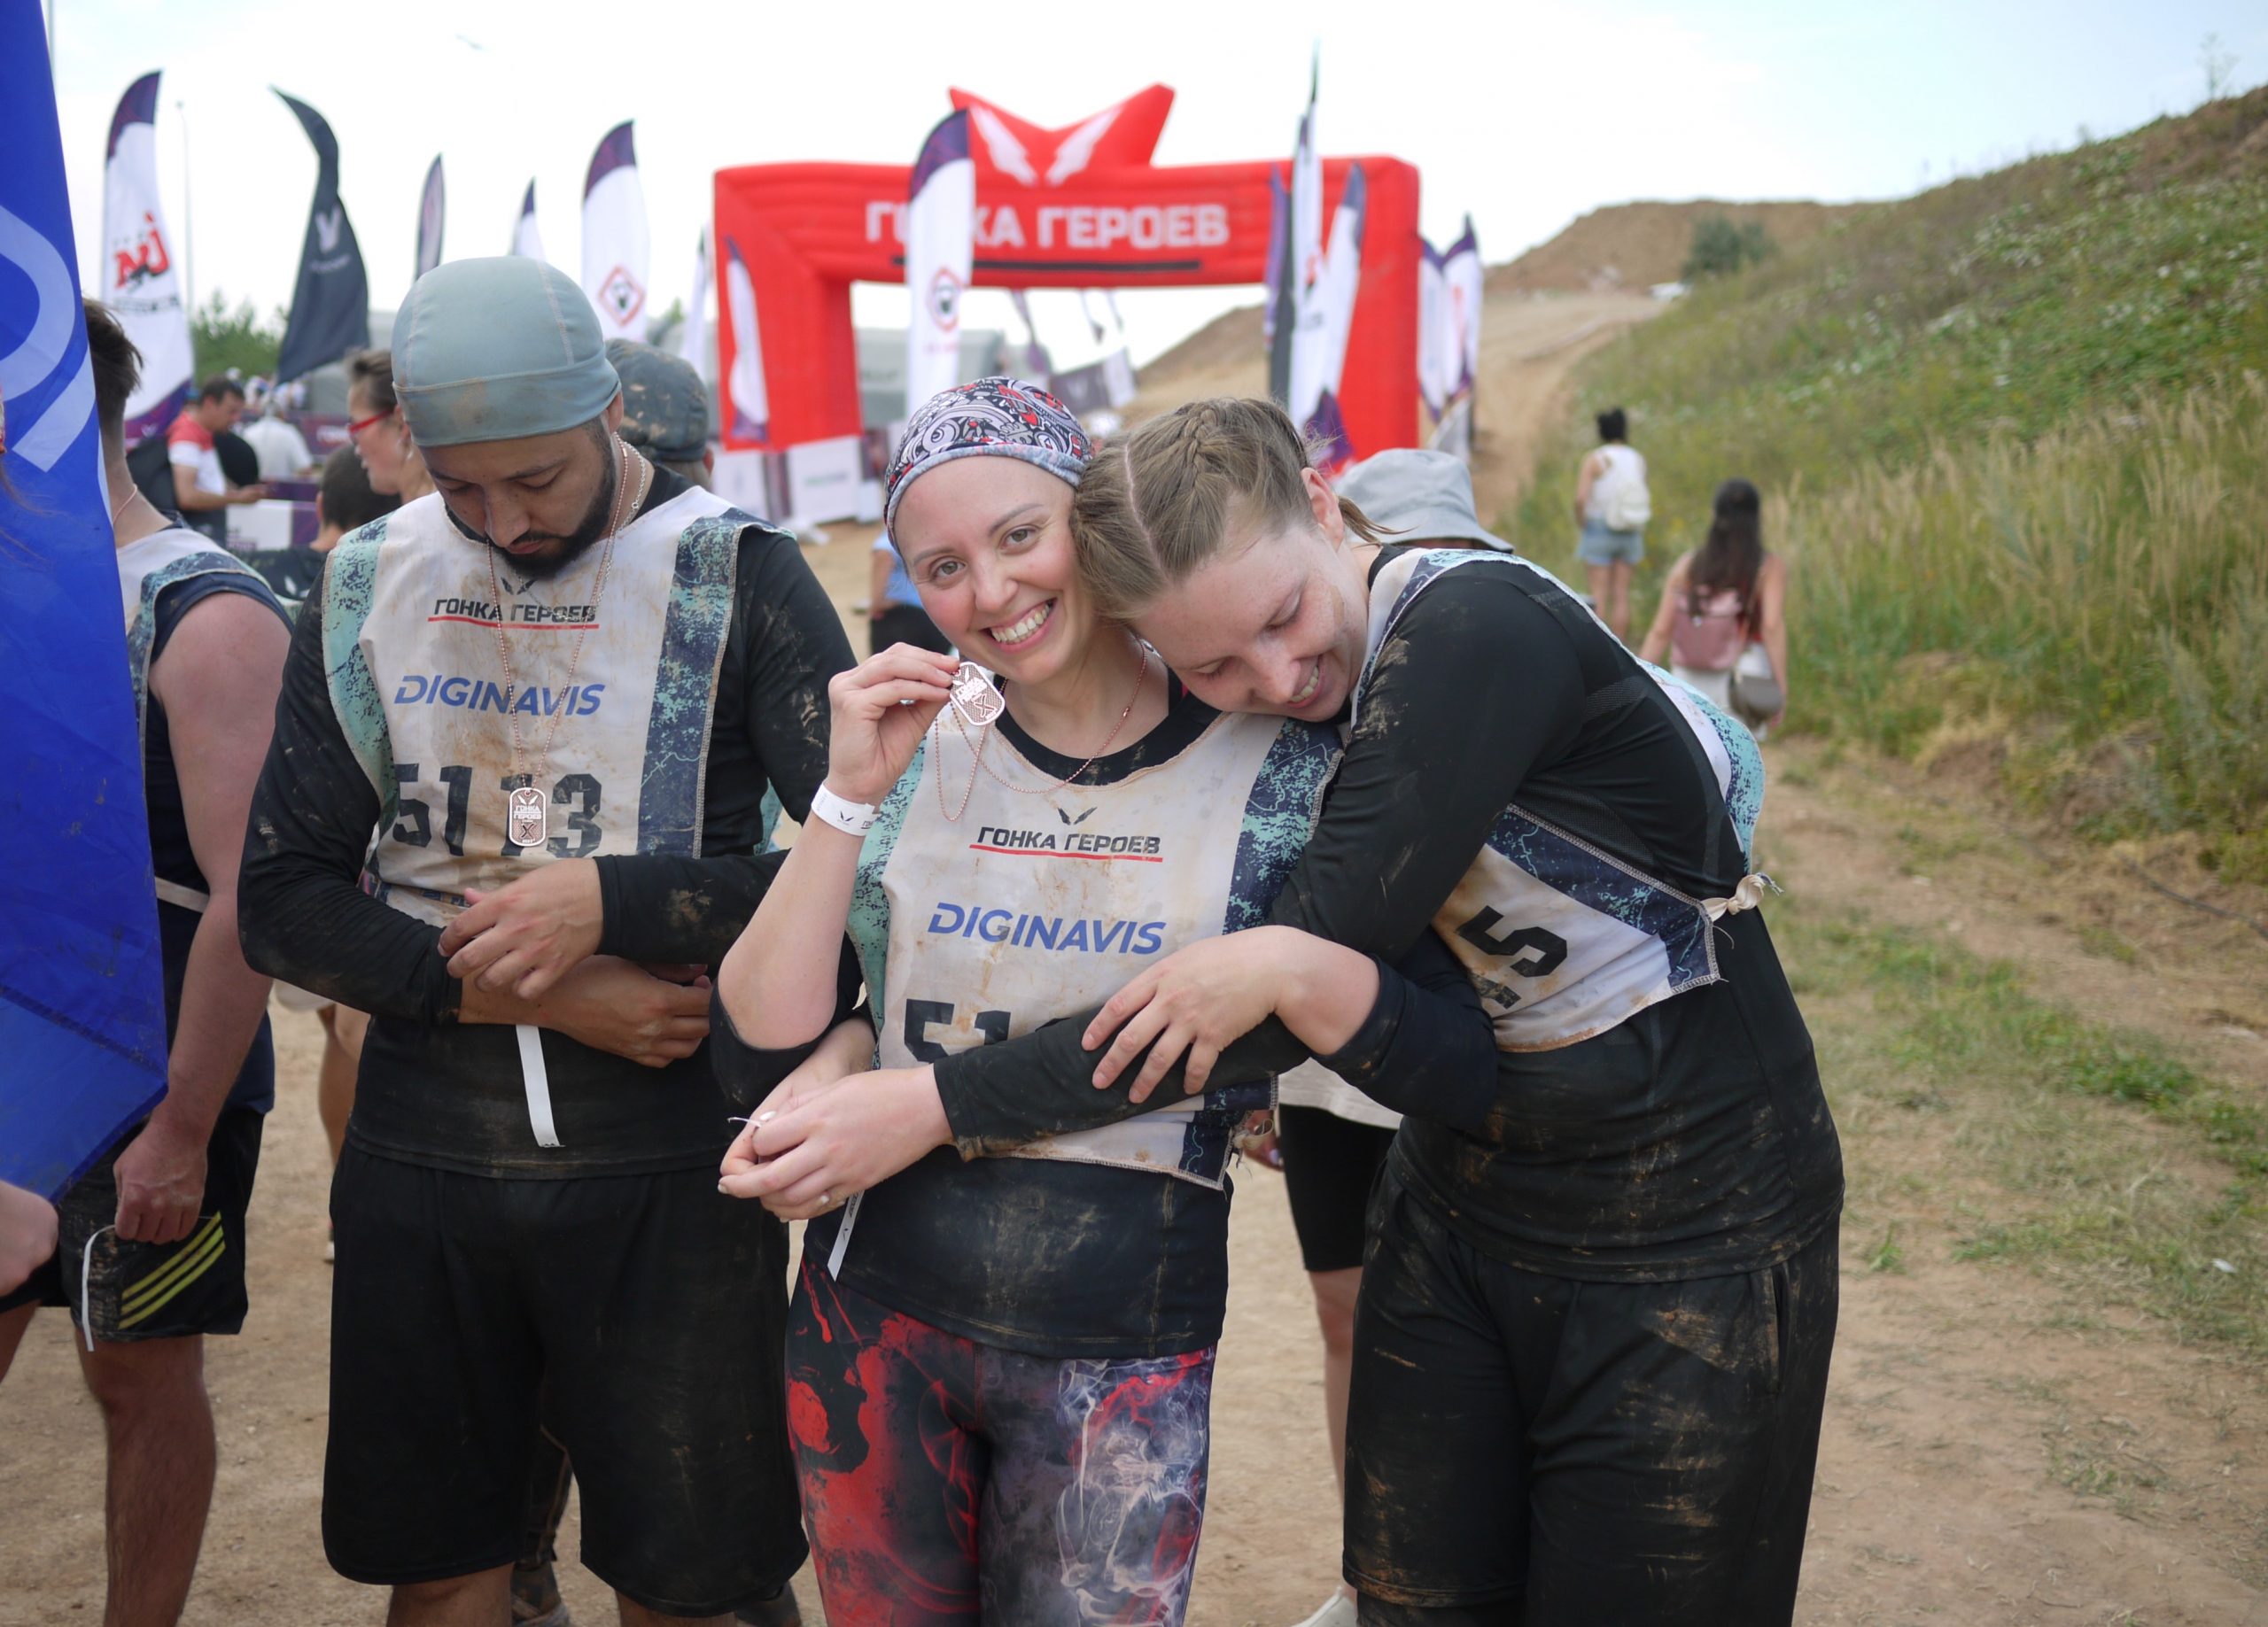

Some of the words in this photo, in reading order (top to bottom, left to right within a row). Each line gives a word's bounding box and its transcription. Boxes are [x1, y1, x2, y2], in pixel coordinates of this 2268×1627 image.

[1037, 204, 1229, 249] ГЕРОЕВ
[434, 598, 502, 622] ГОНКА
[510, 604, 595, 623] ГЕРОЕВ
[393, 675, 606, 716] DIGINAVIS
[977, 826, 1056, 849] ГОНКА
[1064, 833, 1161, 855] ГЕРОЕВ
[928, 902, 1167, 955] DIGINAVIS
